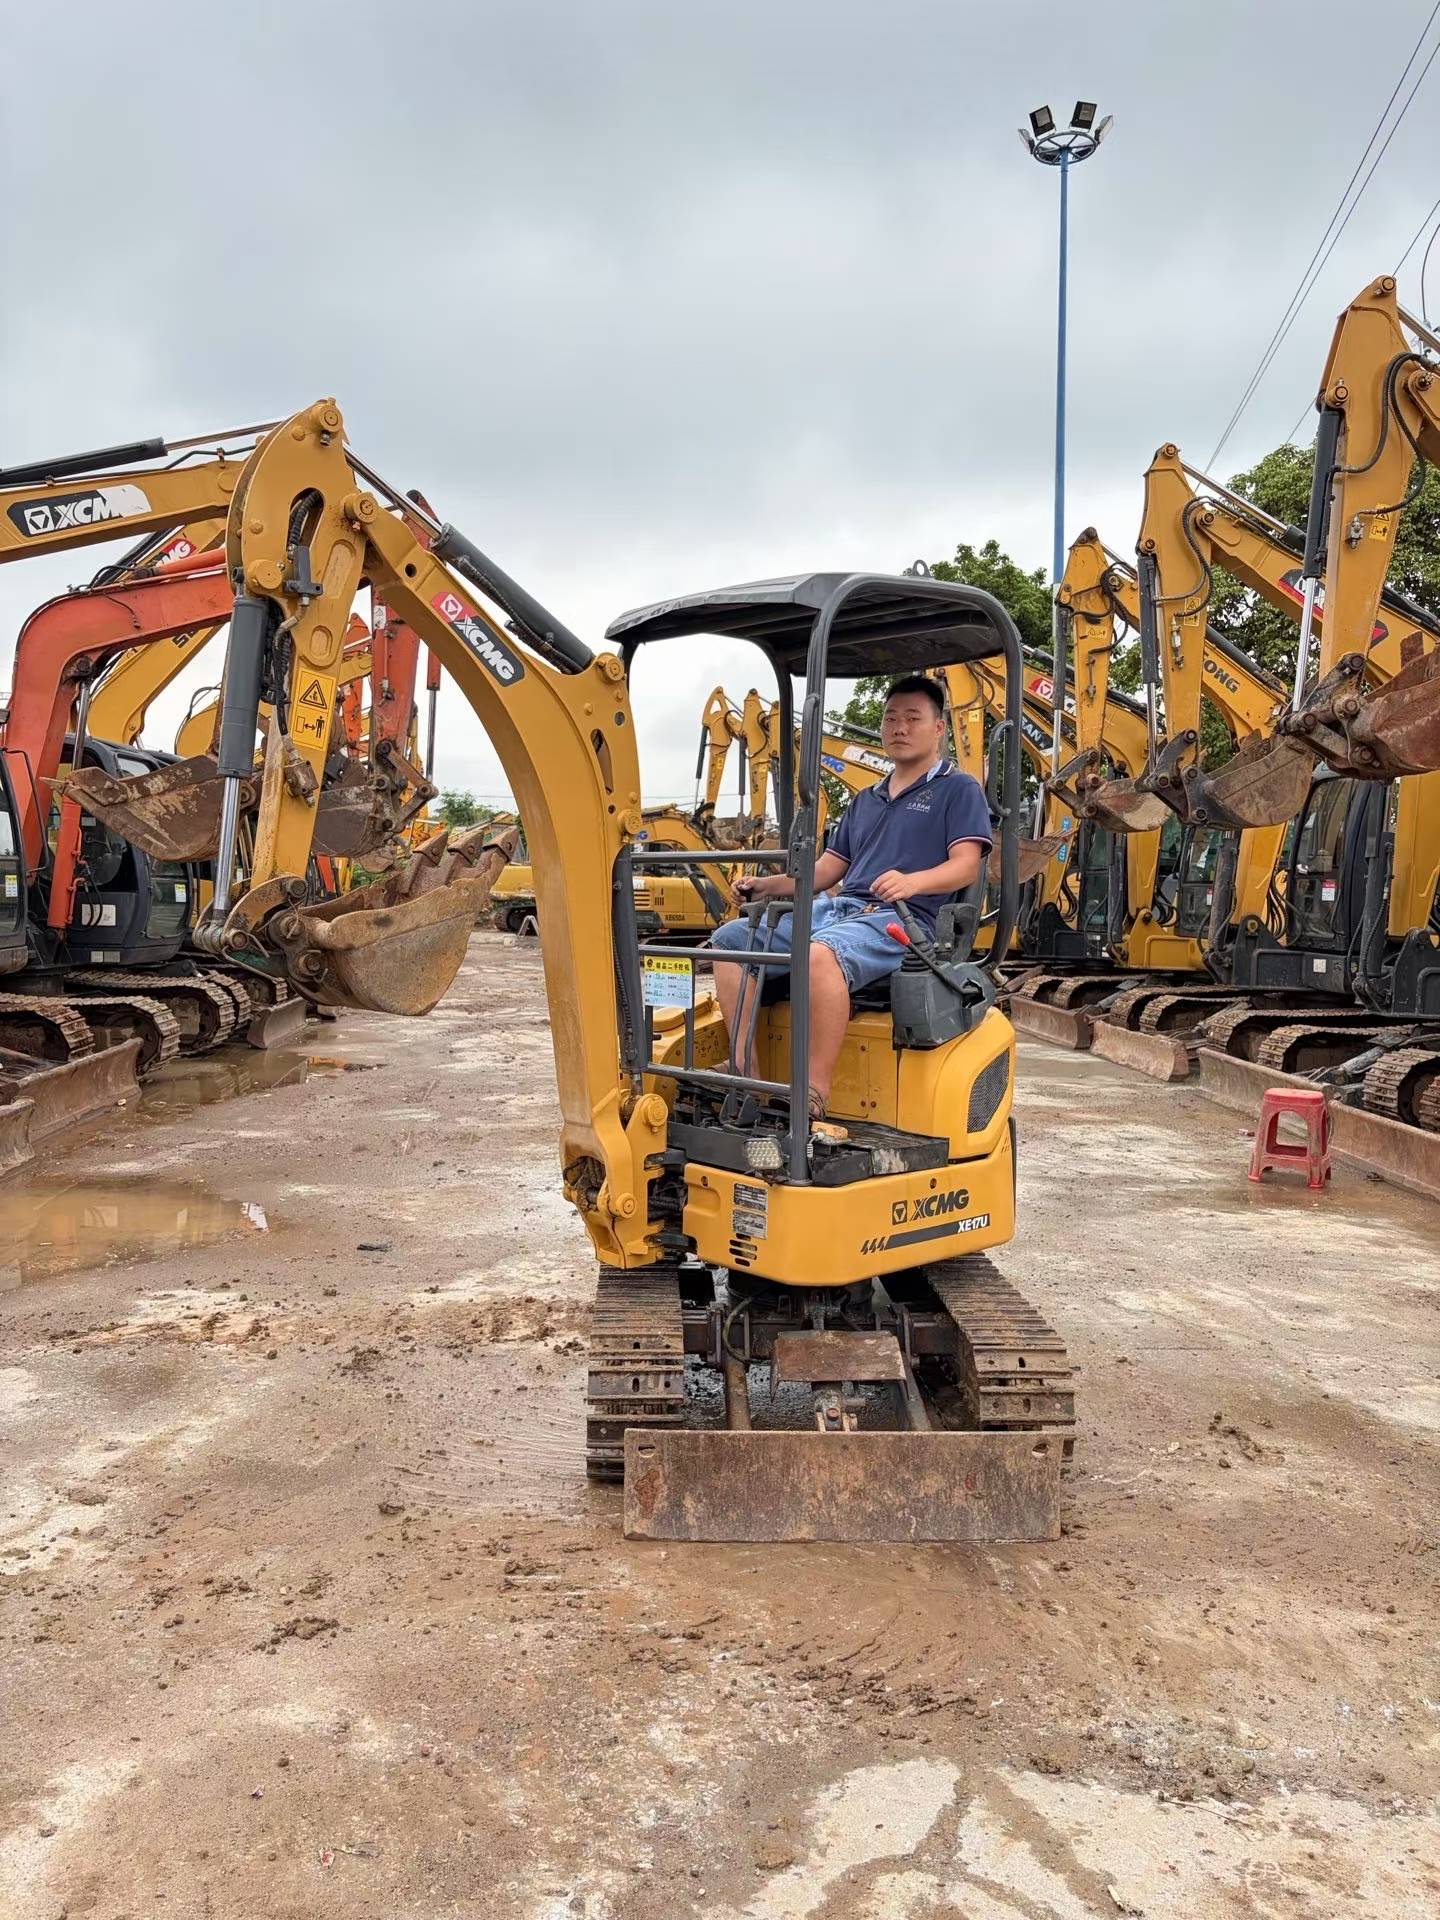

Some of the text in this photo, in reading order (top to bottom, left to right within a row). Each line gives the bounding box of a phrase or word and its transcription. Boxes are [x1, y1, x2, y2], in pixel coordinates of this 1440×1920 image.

[55, 496, 121, 530] XCM
[453, 614, 515, 680] XCMG
[1203, 659, 1241, 694] ONG
[910, 1188, 970, 1222] XCMG
[957, 1215, 989, 1234] XE17U
